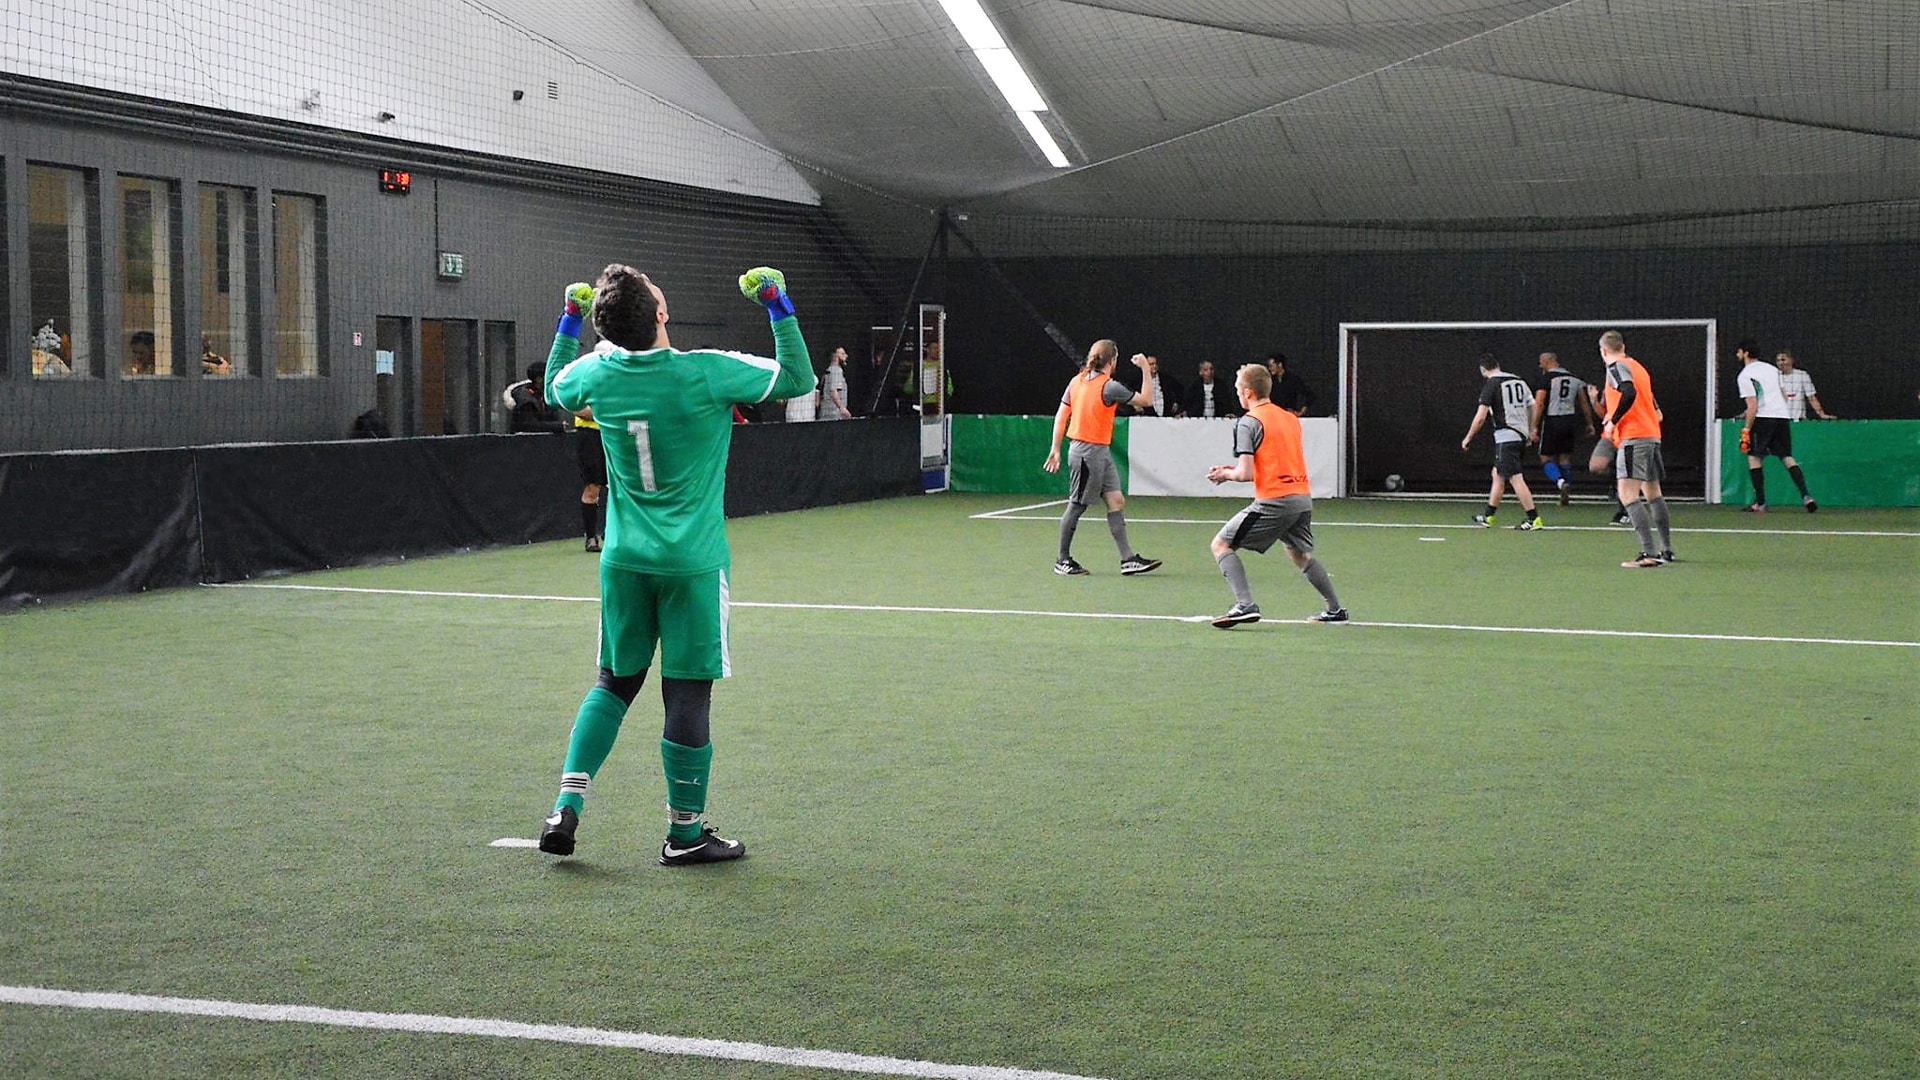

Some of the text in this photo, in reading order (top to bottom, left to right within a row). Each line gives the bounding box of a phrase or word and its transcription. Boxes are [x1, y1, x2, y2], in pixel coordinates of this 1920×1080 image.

[1505, 383, 1524, 404] 10
[1560, 379, 1571, 398] 6
[627, 420, 658, 492] 1
